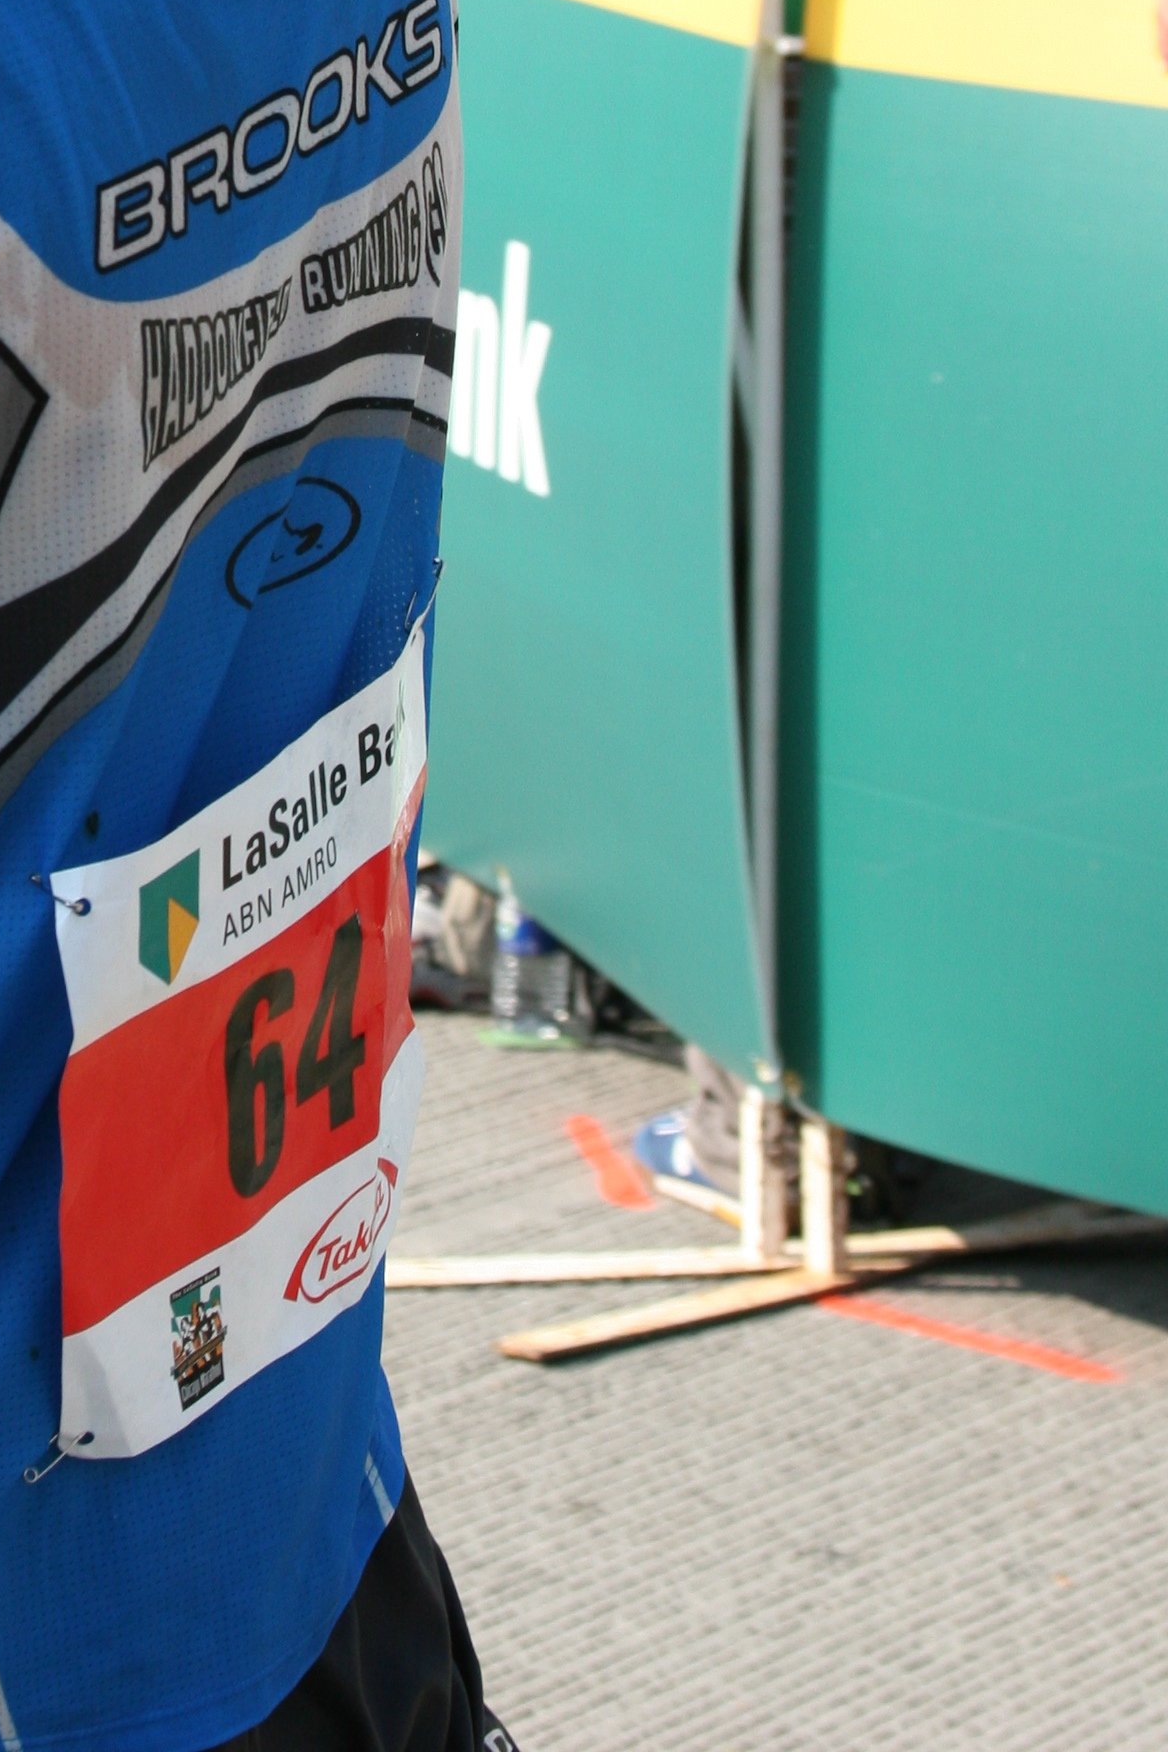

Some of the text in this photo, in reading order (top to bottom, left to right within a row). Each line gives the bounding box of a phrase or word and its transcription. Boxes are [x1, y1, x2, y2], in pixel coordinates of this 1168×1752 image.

[301, 180, 421, 314] RUNNING
[222, 761, 348, 891] LaSalle
[222, 836, 338, 946] ABN AMRO
[224, 910, 366, 1199] 64
